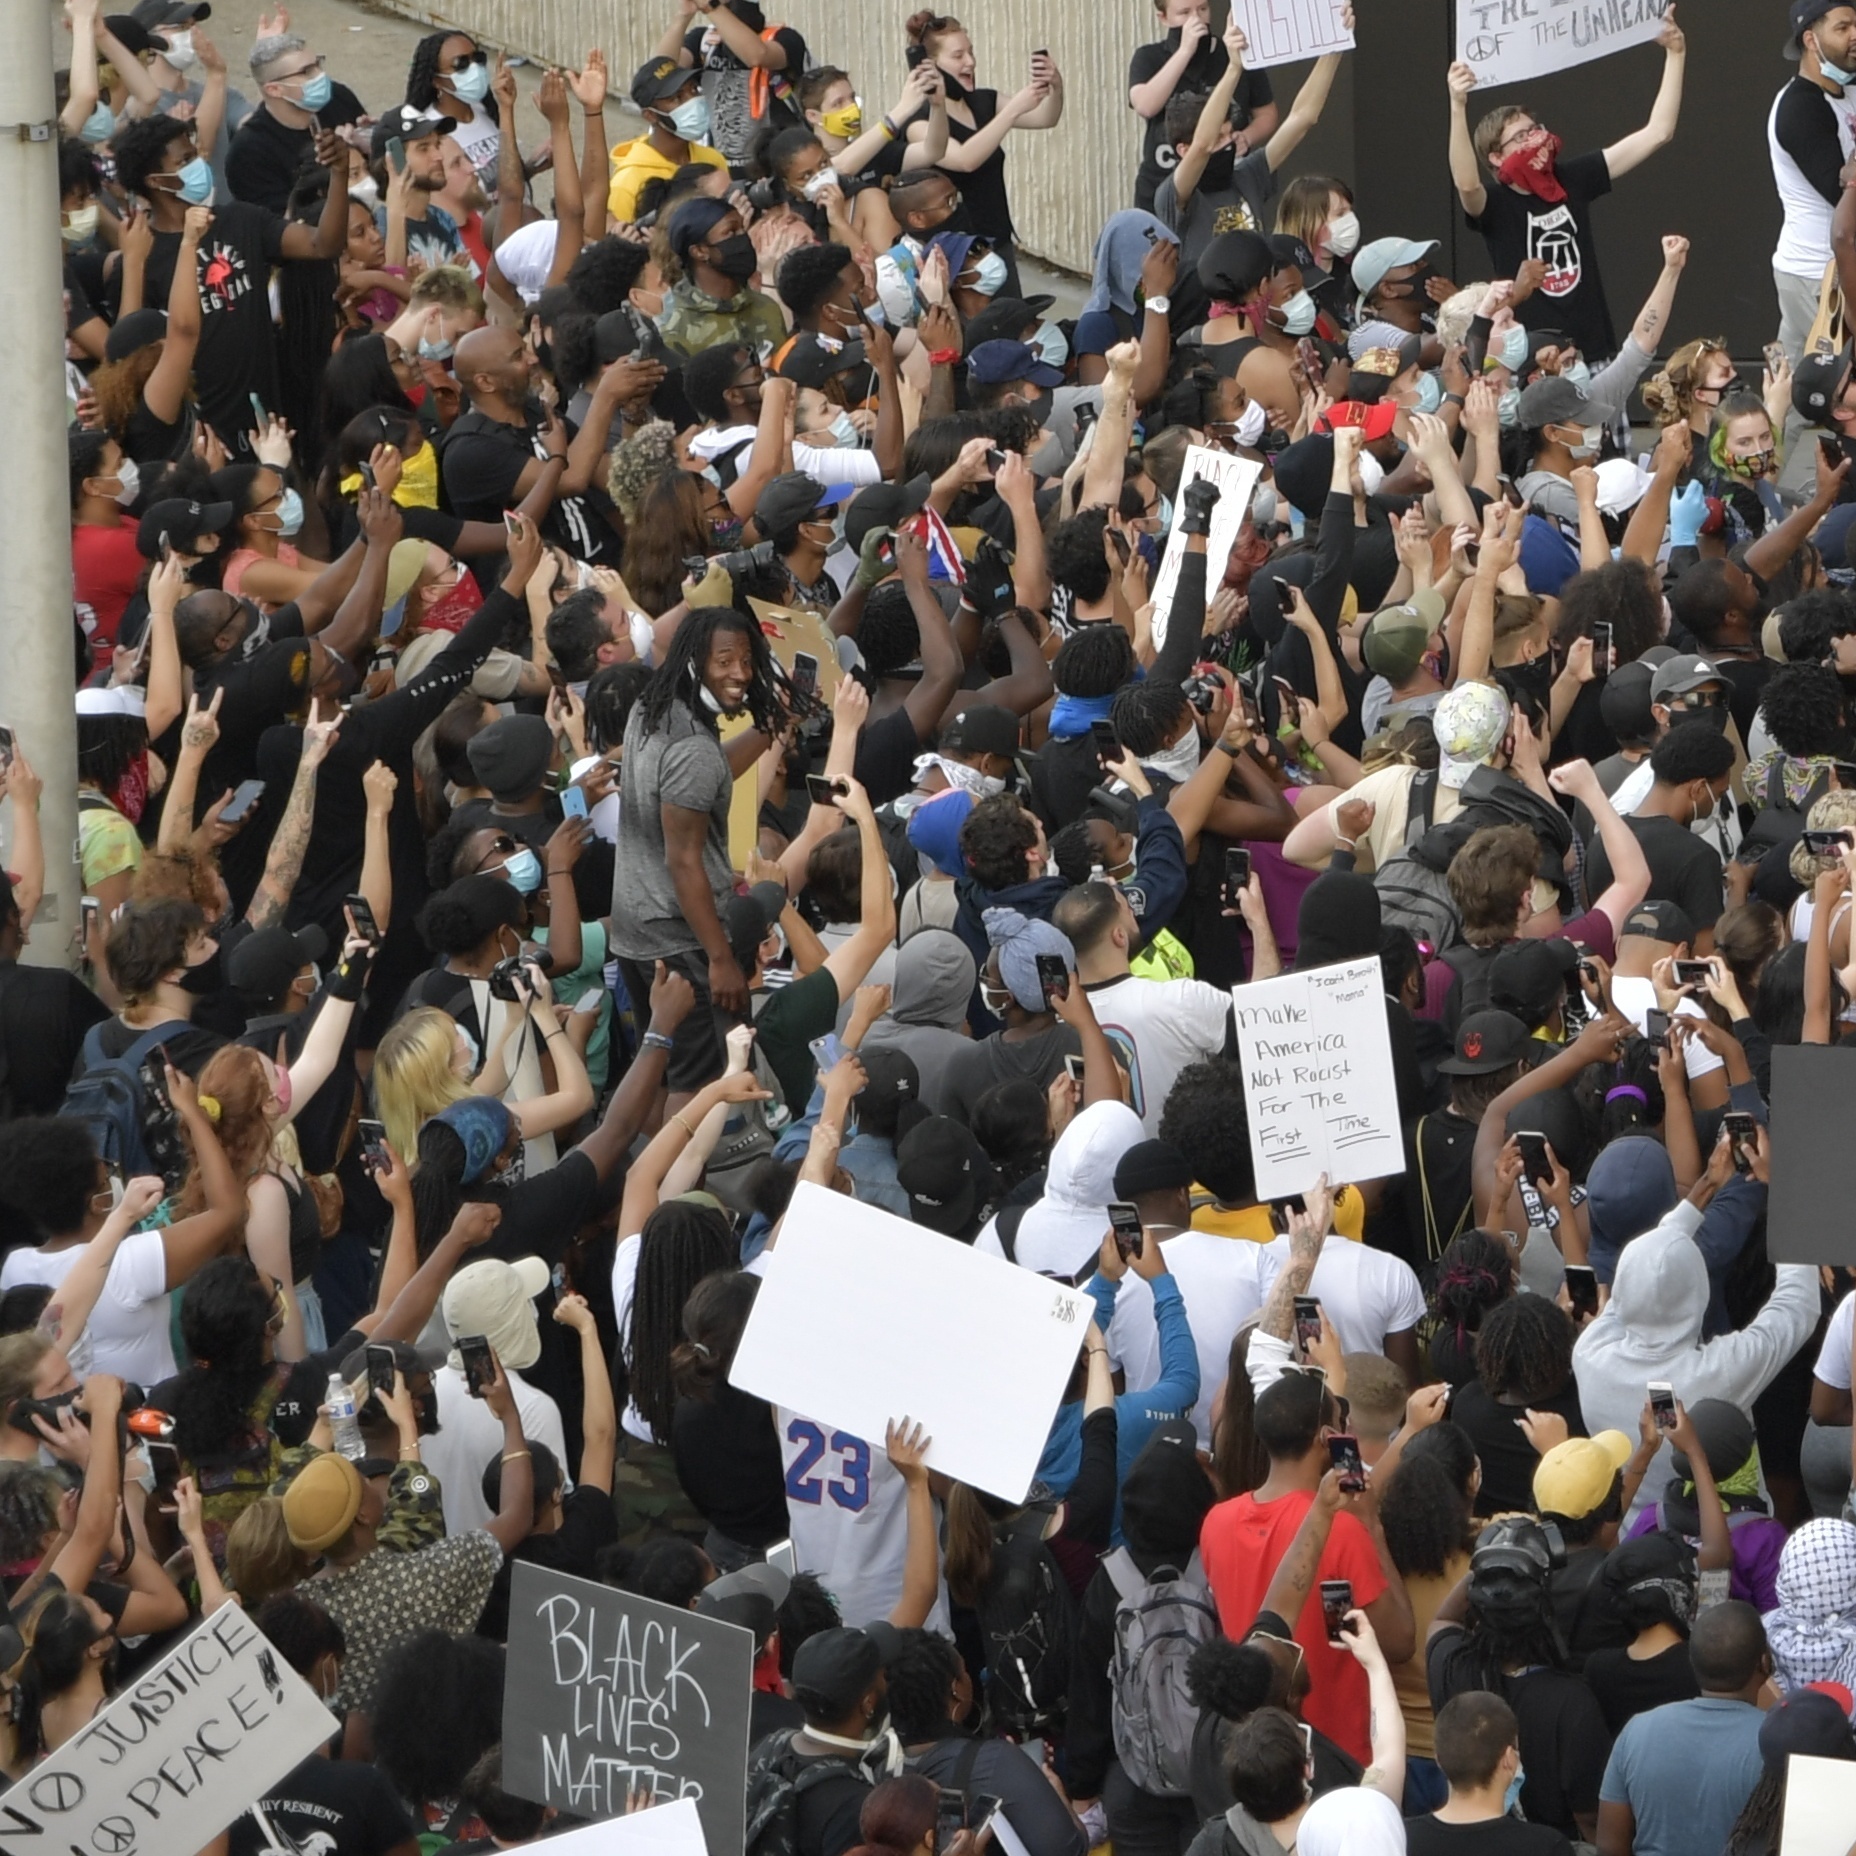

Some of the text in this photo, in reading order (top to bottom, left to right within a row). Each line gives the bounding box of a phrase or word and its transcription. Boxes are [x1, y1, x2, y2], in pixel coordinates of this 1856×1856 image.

[1466, 31, 1515, 62] OF
[1254, 1033, 1347, 1061] America
[1251, 1059, 1352, 1090] Not Racist
[1258, 1091, 1347, 1117] For The
[1258, 1114, 1371, 1148] First Time
[785, 1418, 871, 1514] 23
[536, 1593, 712, 1728] BLACK
[76, 1611, 259, 1767] JUSTICE
[573, 1685, 681, 1762] LIVES
